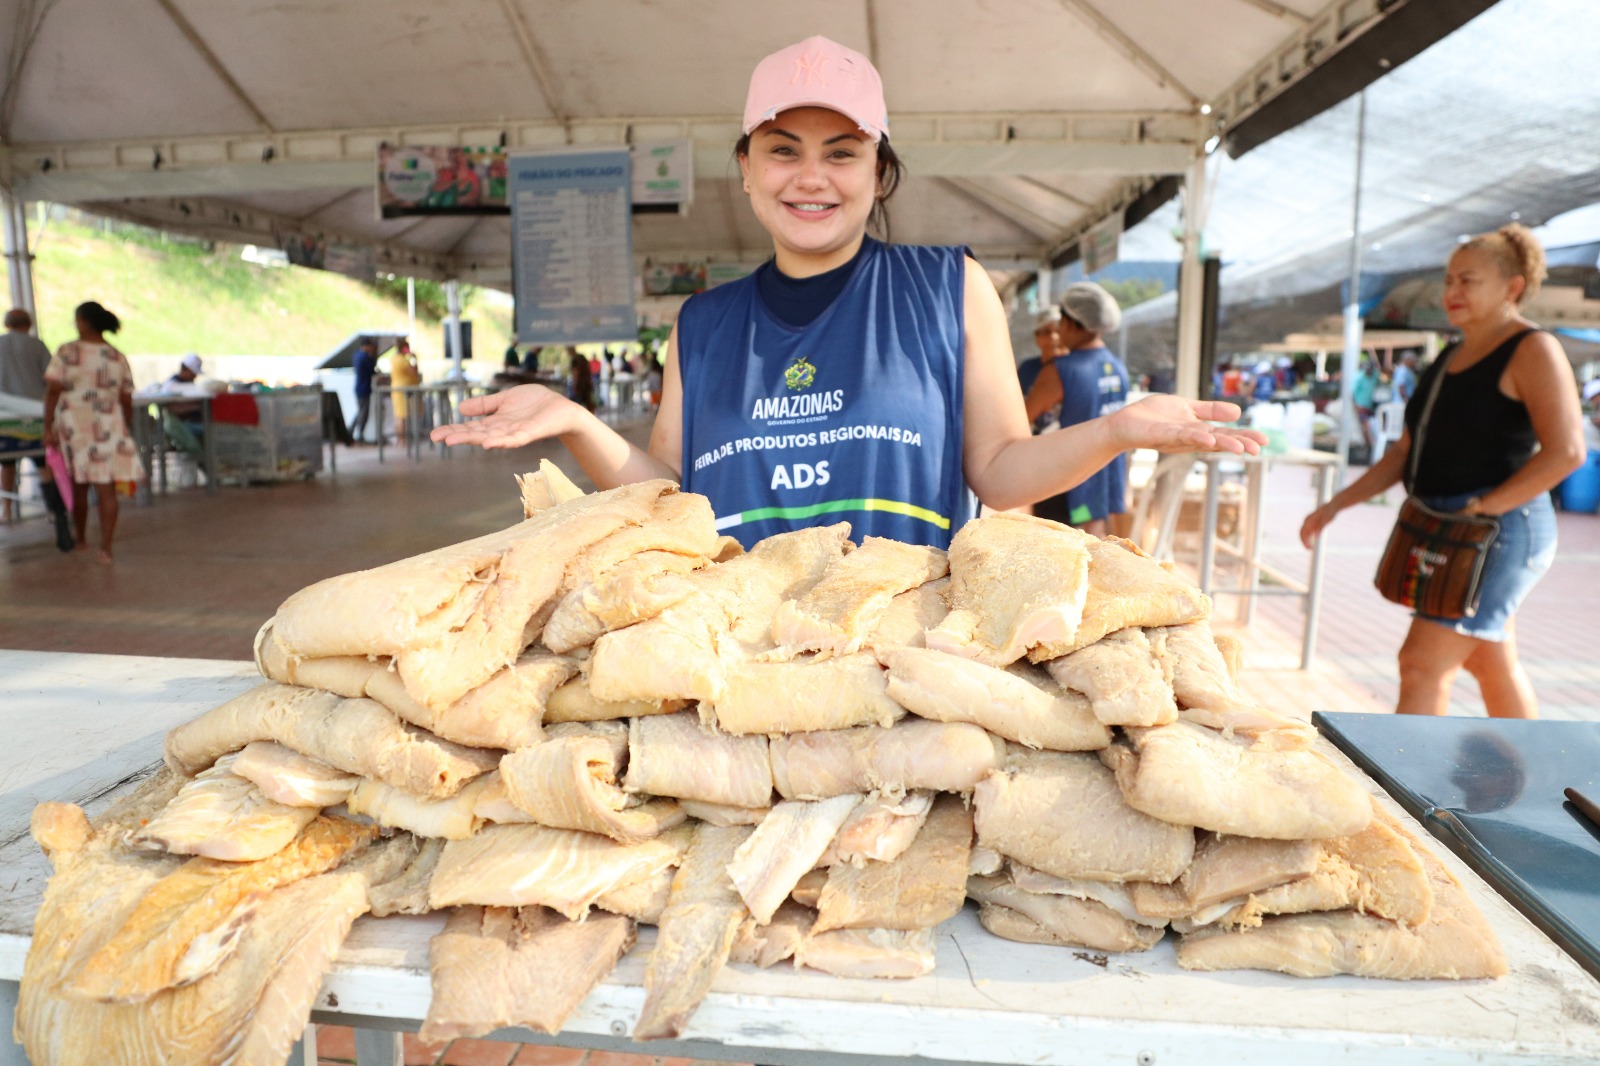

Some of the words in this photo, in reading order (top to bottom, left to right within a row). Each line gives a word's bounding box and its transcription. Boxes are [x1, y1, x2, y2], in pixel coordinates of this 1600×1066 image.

[751, 389, 844, 420] AMAZONAS
[767, 418, 796, 426] GOVERNO
[806, 415, 828, 423] ESTADO
[694, 449, 721, 472] FEIRA
[720, 441, 734, 458] DE
[735, 432, 818, 454] PRODUTOS
[819, 425, 901, 445] REGIONAIS
[902, 430, 922, 447] DA
[770, 460, 831, 491] ADS
